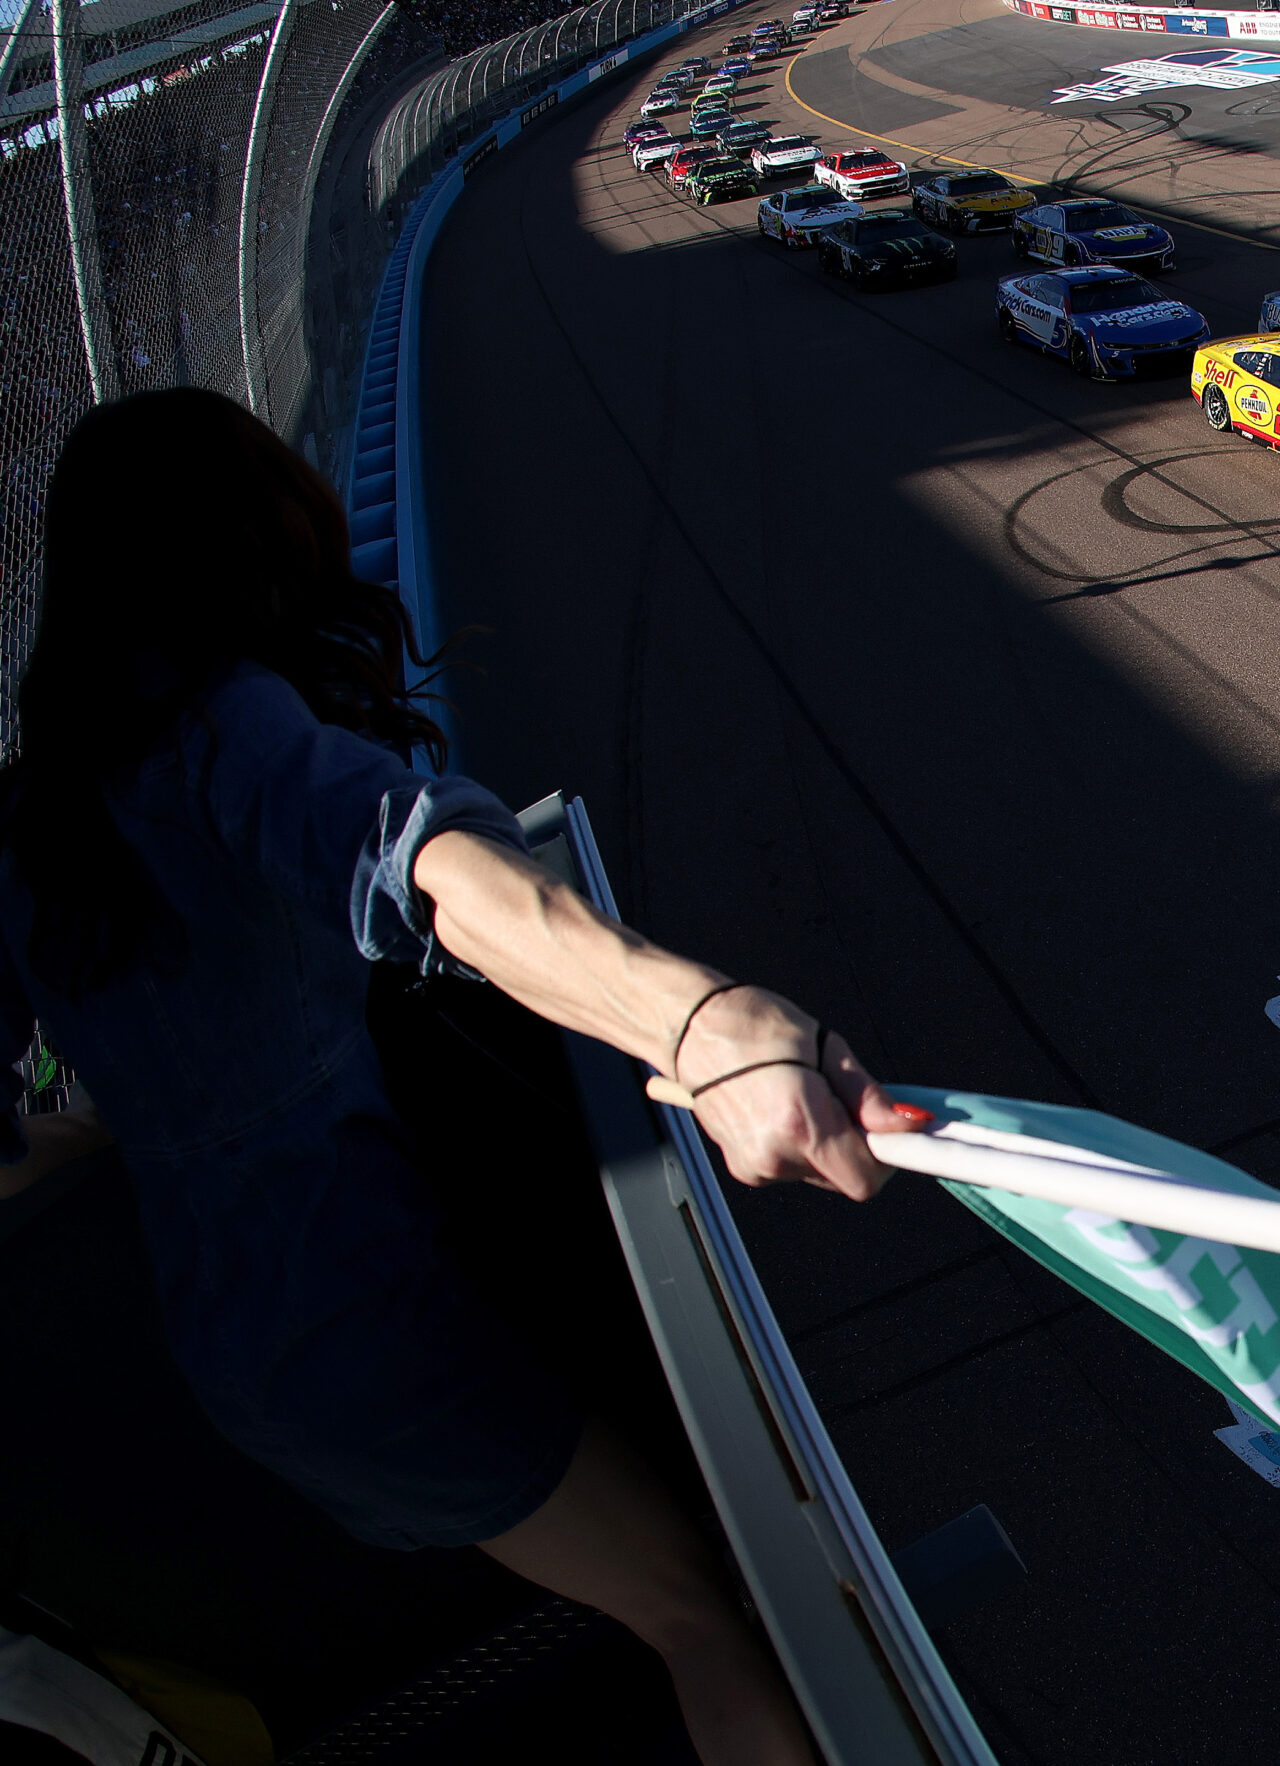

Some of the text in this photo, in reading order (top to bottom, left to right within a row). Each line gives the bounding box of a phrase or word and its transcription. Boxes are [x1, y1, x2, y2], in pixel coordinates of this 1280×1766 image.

[1053, 234, 1064, 256] 9
[1204, 360, 1236, 389] Shell
[1241, 397, 1268, 413] PENNZOIL
